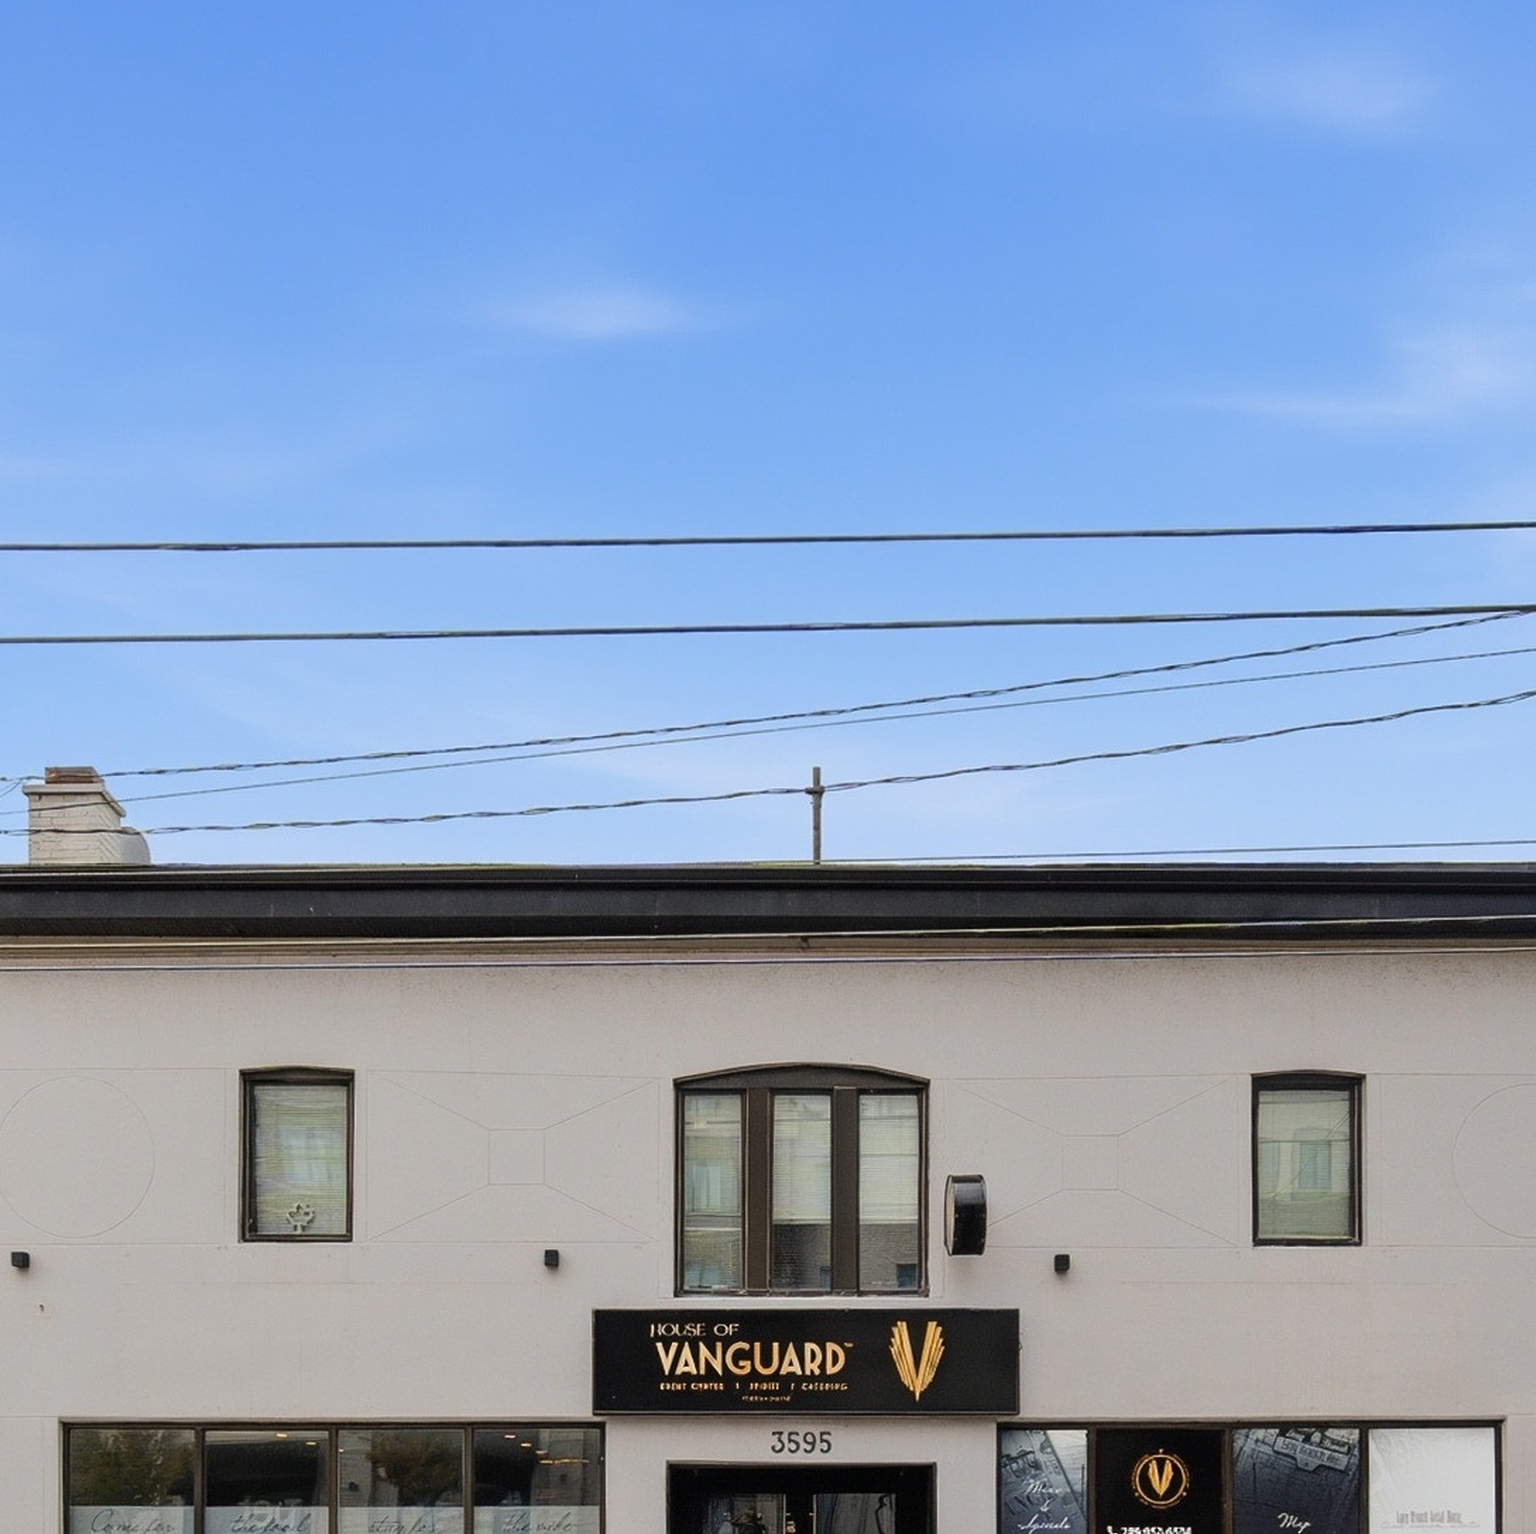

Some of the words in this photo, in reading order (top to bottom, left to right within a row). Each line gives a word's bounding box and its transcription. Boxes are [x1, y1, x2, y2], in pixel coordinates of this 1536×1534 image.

[649, 1323, 706, 1338] HOUSE
[714, 1323, 739, 1337] OF
[655, 1341, 846, 1376] VANGUARD
[771, 1431, 832, 1454] 3595
